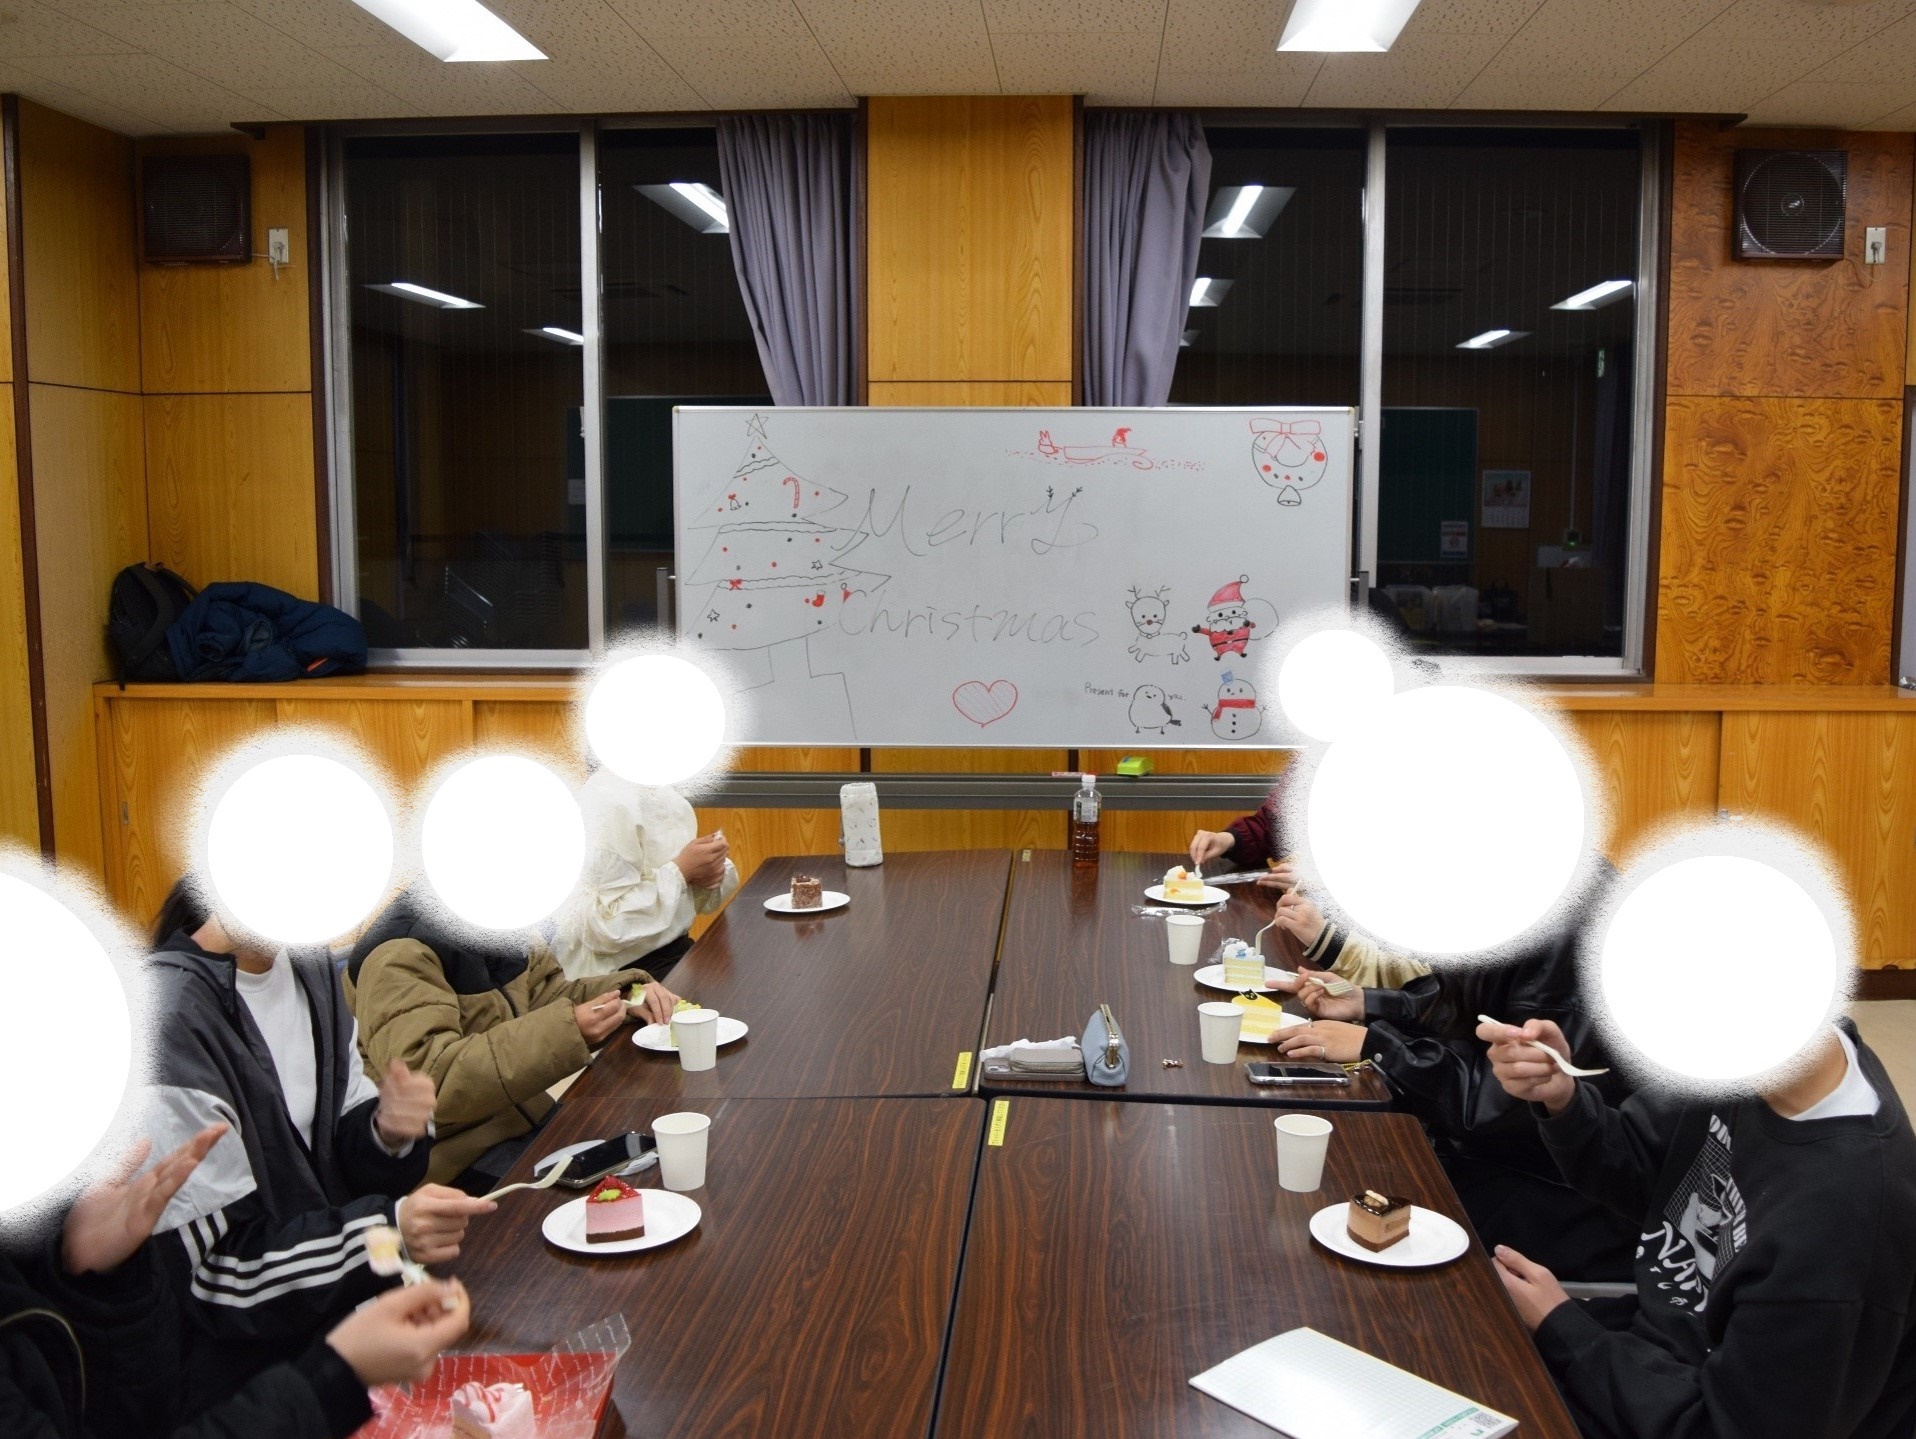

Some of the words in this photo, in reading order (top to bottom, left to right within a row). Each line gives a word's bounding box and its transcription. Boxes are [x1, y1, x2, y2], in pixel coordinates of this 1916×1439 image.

[831, 485, 1098, 557] Merry
[839, 588, 1099, 646] Christmas
[1084, 681, 1114, 696] Present
[1118, 689, 1129, 698] for
